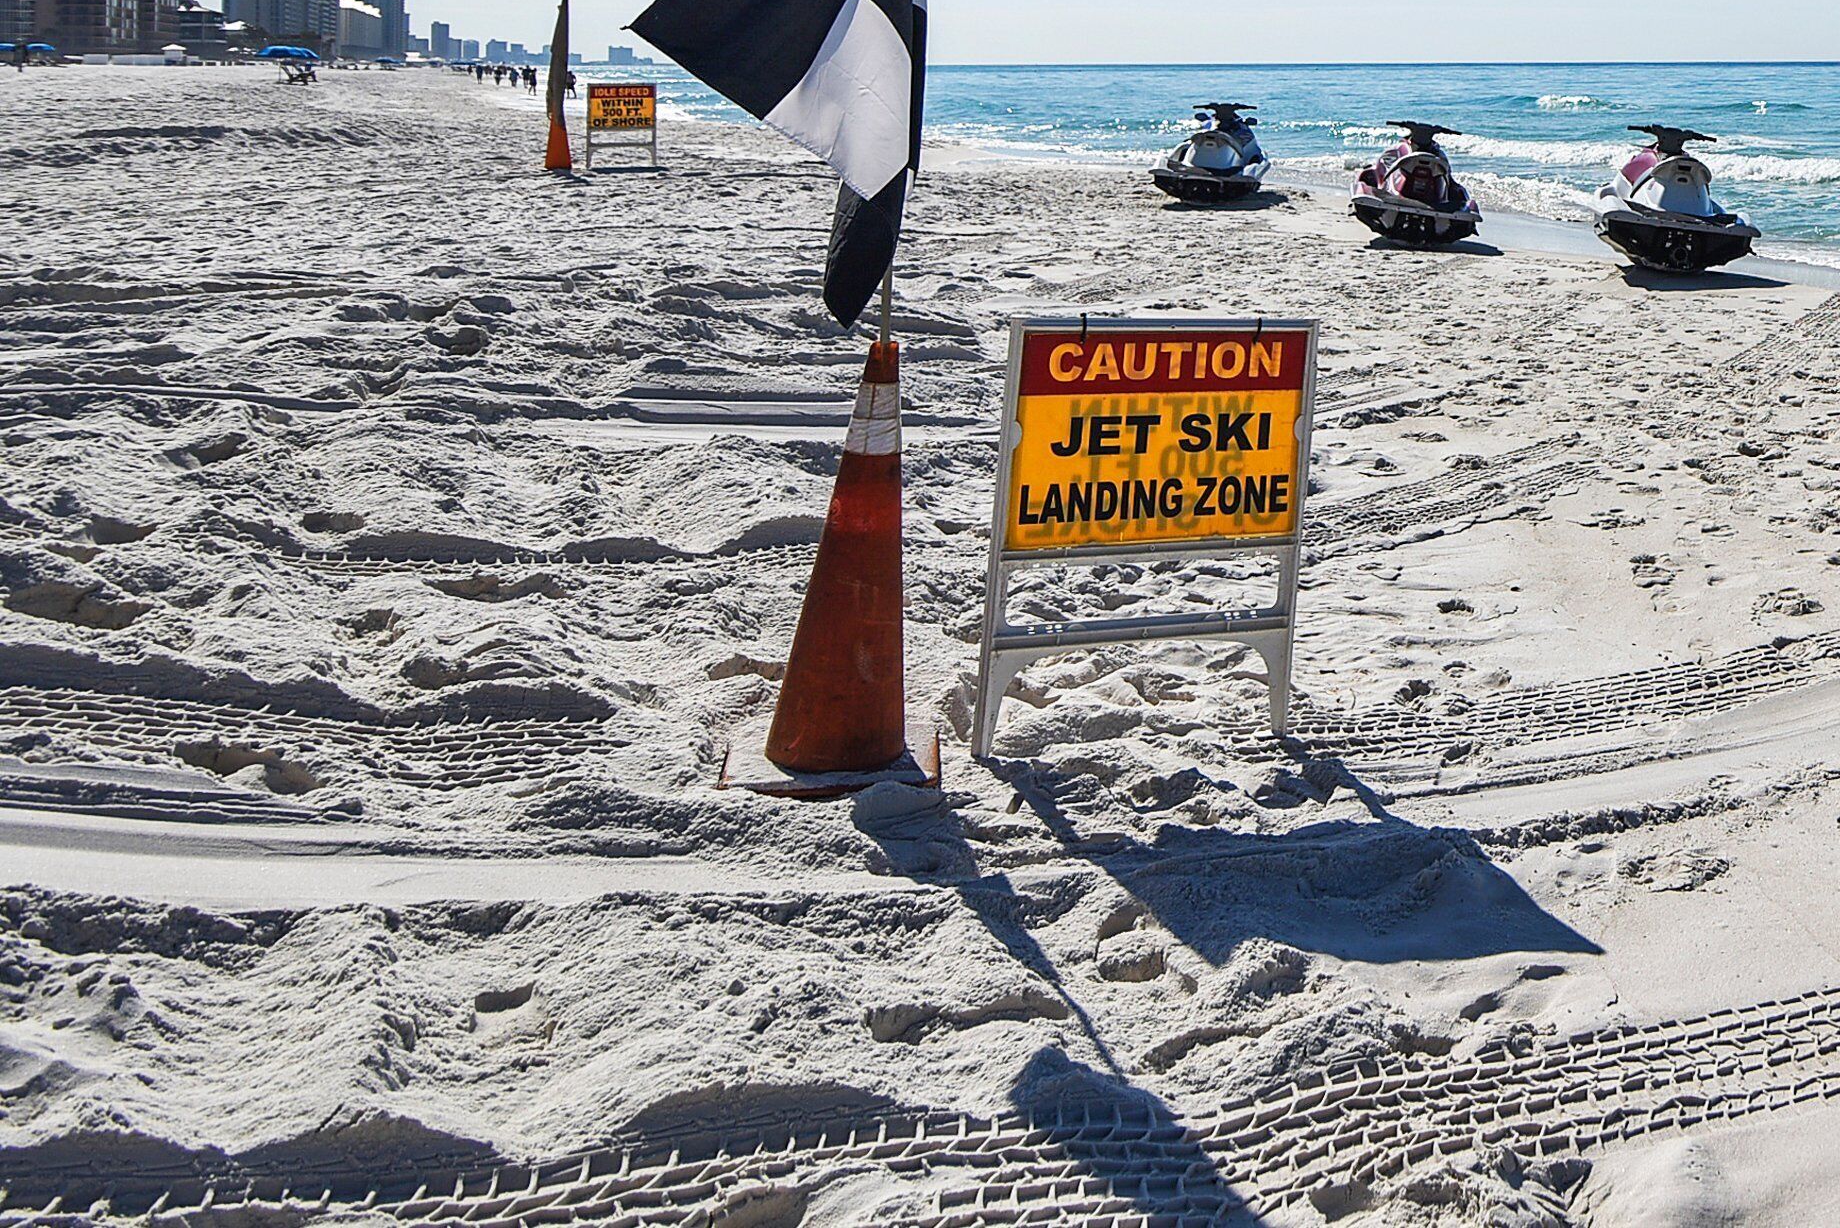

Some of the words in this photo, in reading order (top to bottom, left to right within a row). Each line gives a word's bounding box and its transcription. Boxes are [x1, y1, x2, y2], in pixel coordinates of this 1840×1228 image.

[594, 87, 617, 97] IDLE
[618, 87, 649, 96] SPEED
[601, 99, 643, 107] WITHIN
[602, 108, 623, 117] 500
[626, 108, 642, 116] FT.
[593, 118, 608, 127] OF
[612, 117, 651, 126] SHORE
[1048, 340, 1284, 383] CAUTION
[1049, 414, 1162, 457] JET
[1177, 411, 1272, 453] SKI
[1017, 476, 1183, 526] LANDING
[1193, 473, 1290, 517] ZONE
